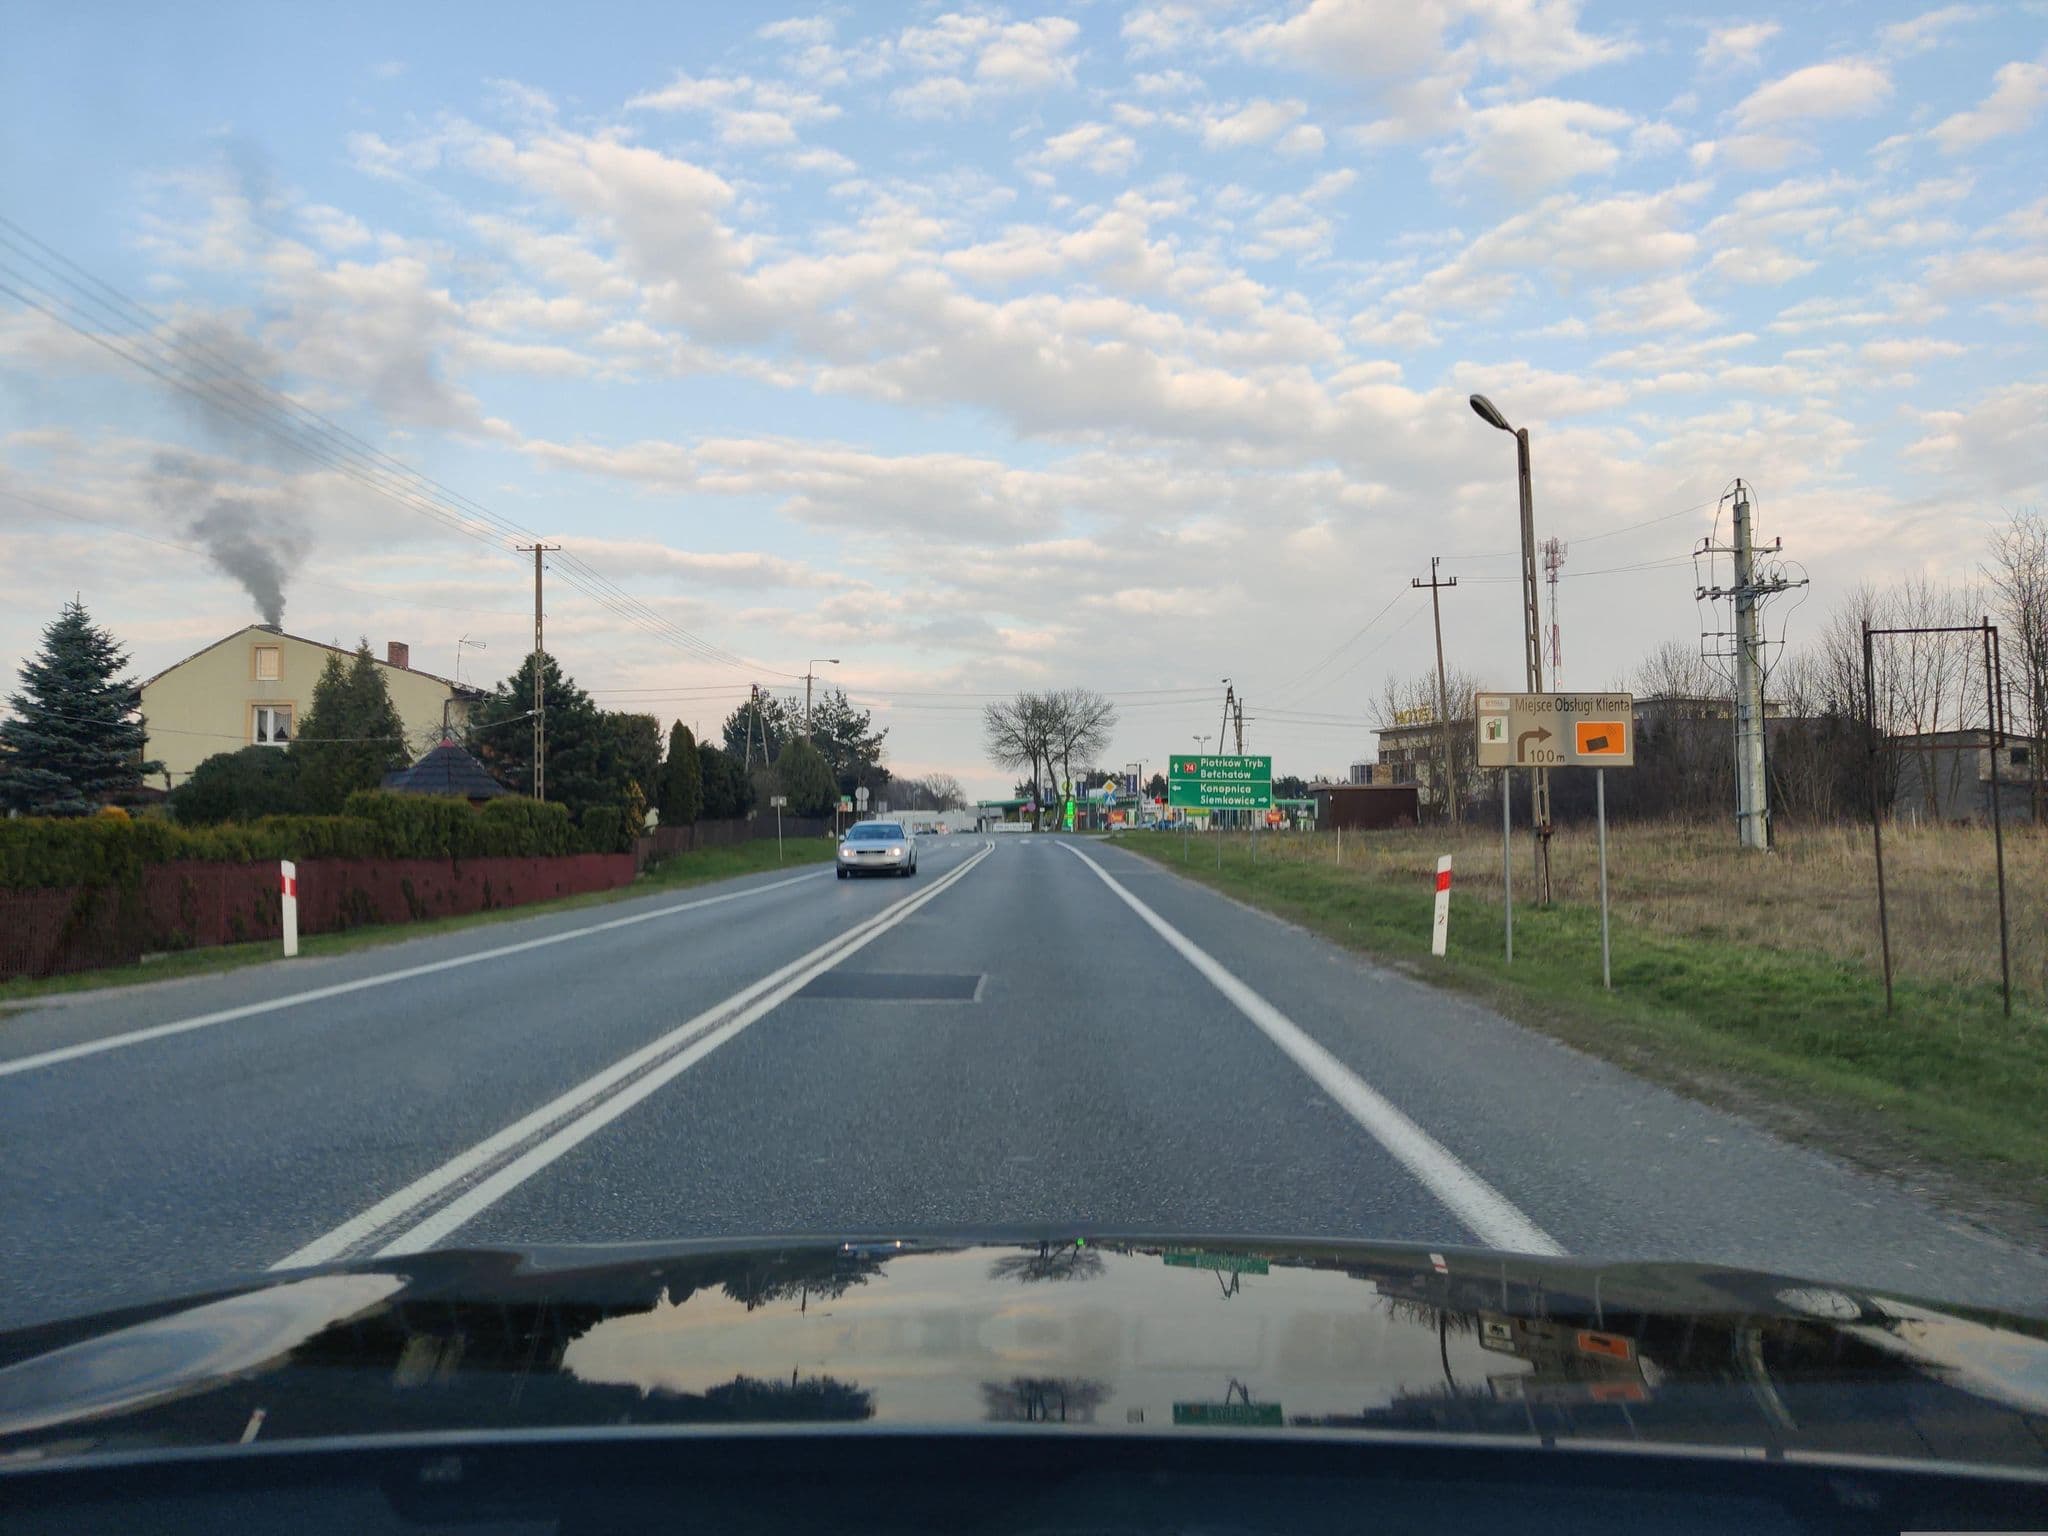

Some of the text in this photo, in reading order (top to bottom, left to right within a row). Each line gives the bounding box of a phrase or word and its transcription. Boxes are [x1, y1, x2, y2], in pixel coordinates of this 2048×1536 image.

[1515, 697, 1552, 716] Miejsce
[1555, 697, 1593, 716] Obsługi
[1596, 697, 1630, 712] Klienta
[1200, 758, 1266, 770] Piotrków Tryb.
[1200, 768, 1251, 779] Bełchatów
[1200, 784, 1251, 795] Konopnica
[1200, 795, 1255, 805] Siemkowice
